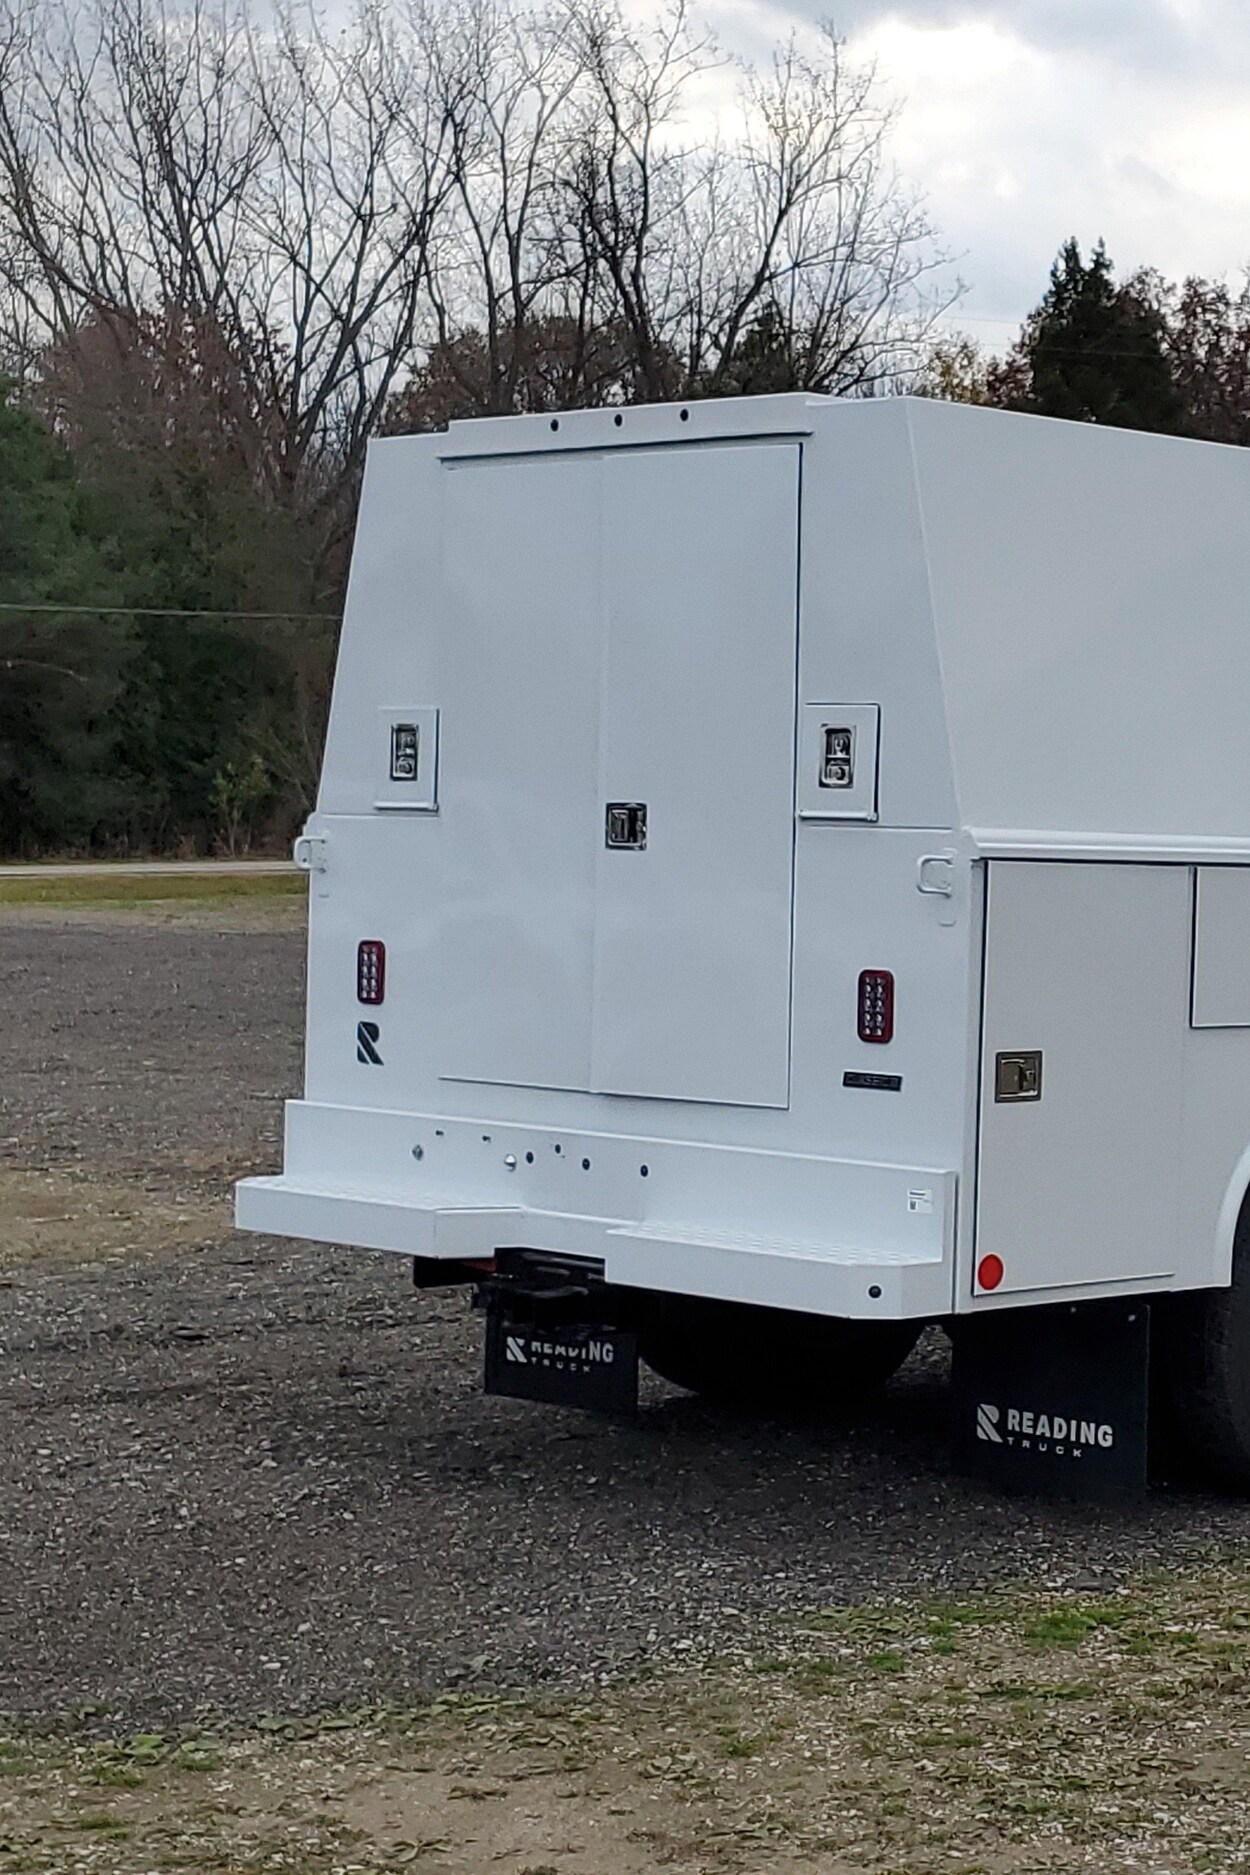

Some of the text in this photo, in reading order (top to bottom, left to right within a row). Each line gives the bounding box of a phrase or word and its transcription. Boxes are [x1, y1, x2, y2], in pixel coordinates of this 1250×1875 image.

[531, 1357, 591, 1374] TRUCK
[1007, 1408, 1113, 1448] READING
[1006, 1437, 1082, 1458] TRUCK
